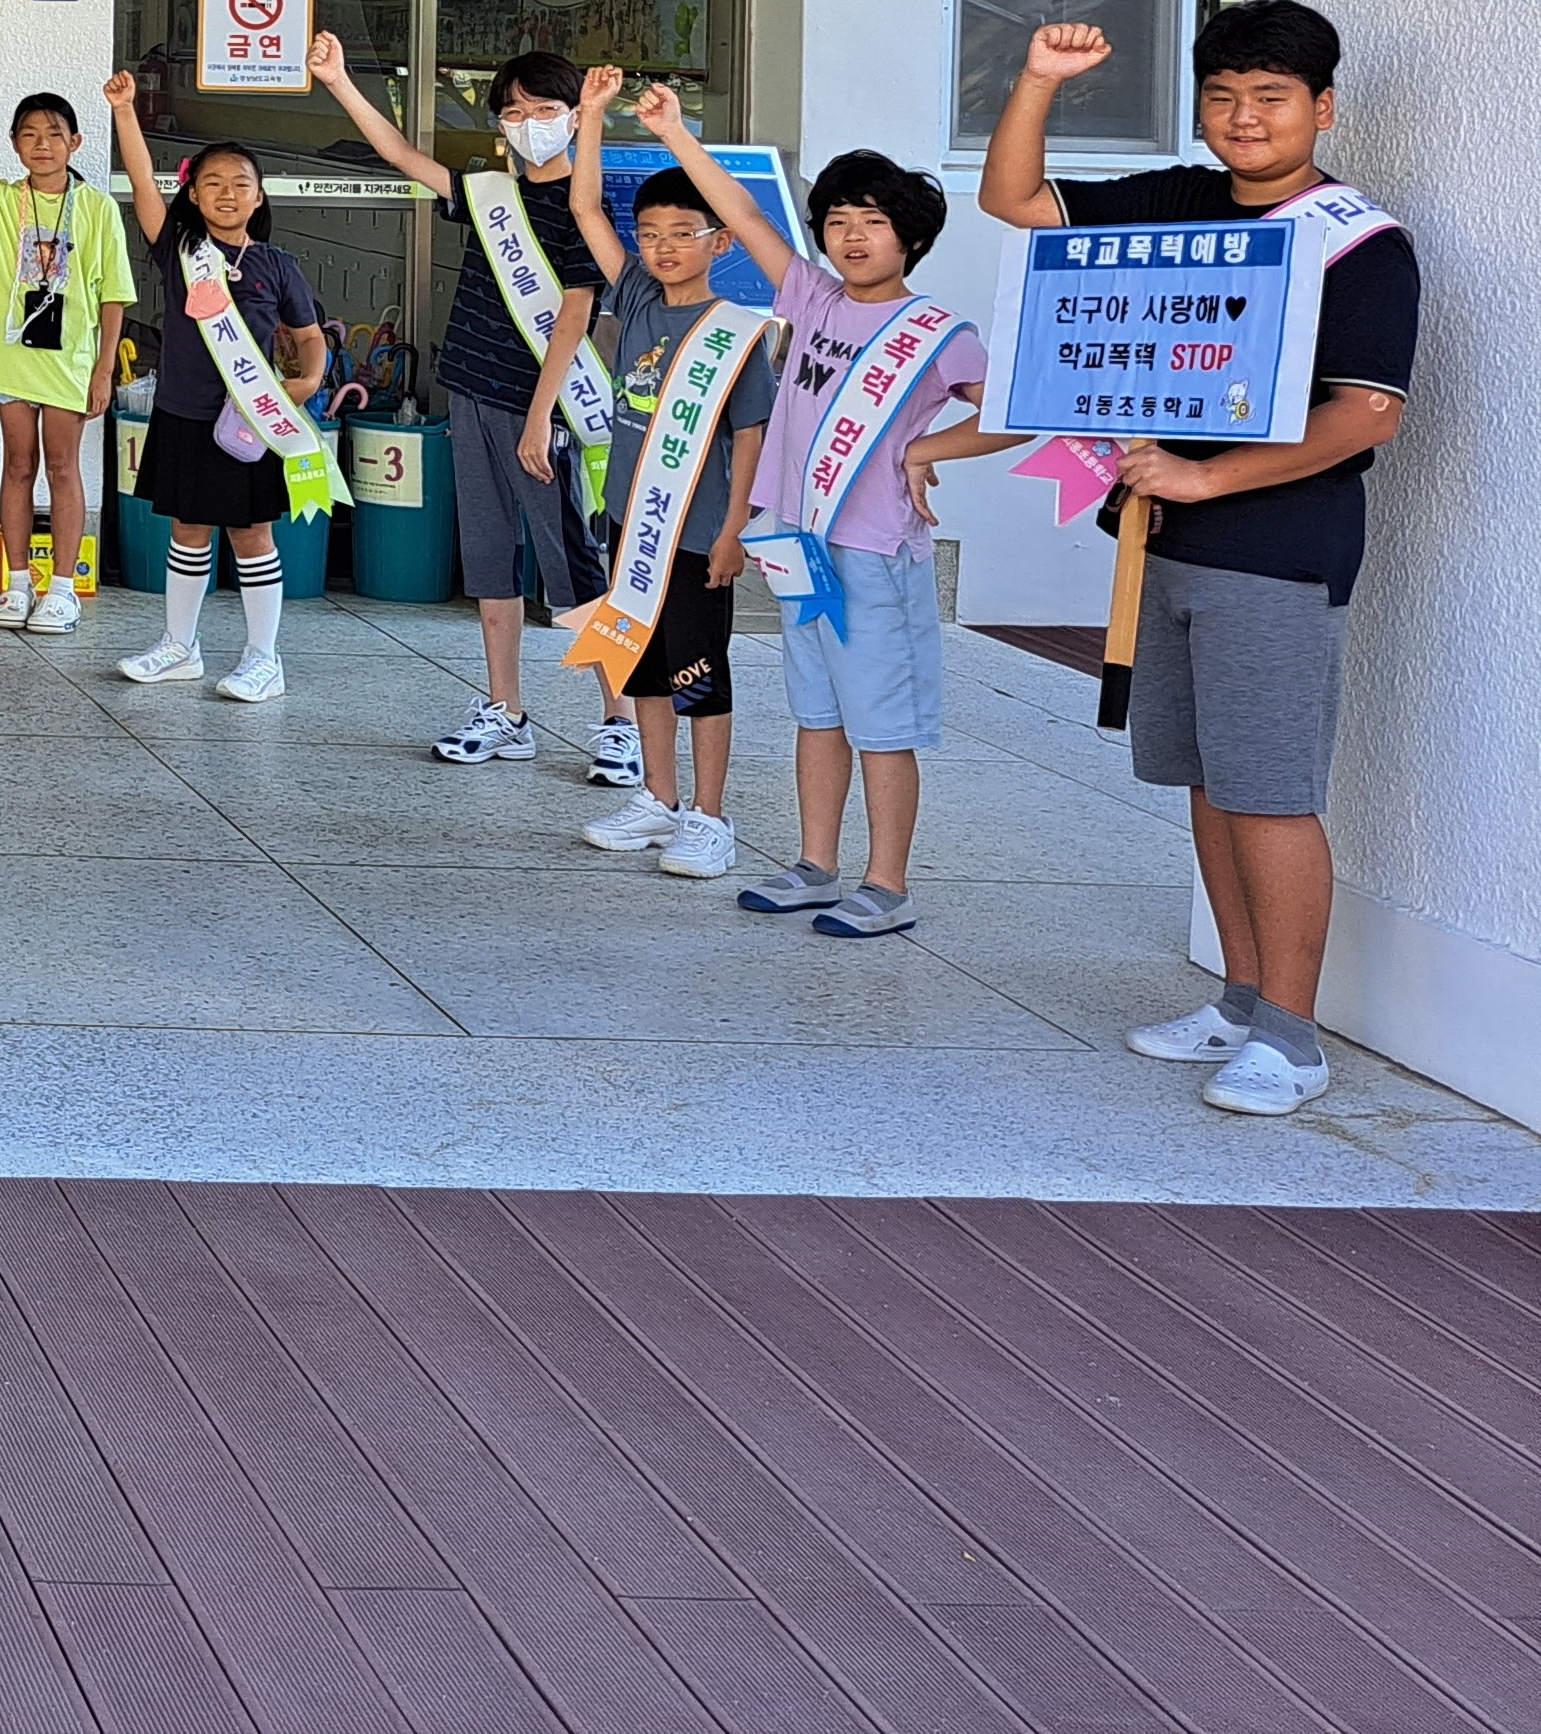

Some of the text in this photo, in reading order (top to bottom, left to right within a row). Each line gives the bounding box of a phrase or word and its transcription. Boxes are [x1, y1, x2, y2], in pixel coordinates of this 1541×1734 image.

[227, 34, 282, 59] 금연
[313, 182, 413, 195] 안전거리를 지켜주세요
[1066, 231, 1251, 267] 학교폭력예방
[488, 205, 613, 434] 우정을 물친다
[1054, 295, 1219, 325] 친구야 사랑해
[1057, 341, 1234, 371] 학교폭력 STOP
[233, 356, 259, 384] 쓴
[252, 392, 301, 437] 폭력
[661, 326, 738, 471] 폭력예방
[1073, 394, 1205, 419] 외동초등학교
[811, 415, 866, 533] 멈춰!
[628, 485, 673, 595] 첫걸음
[590, 619, 643, 655] 외동초등학교
